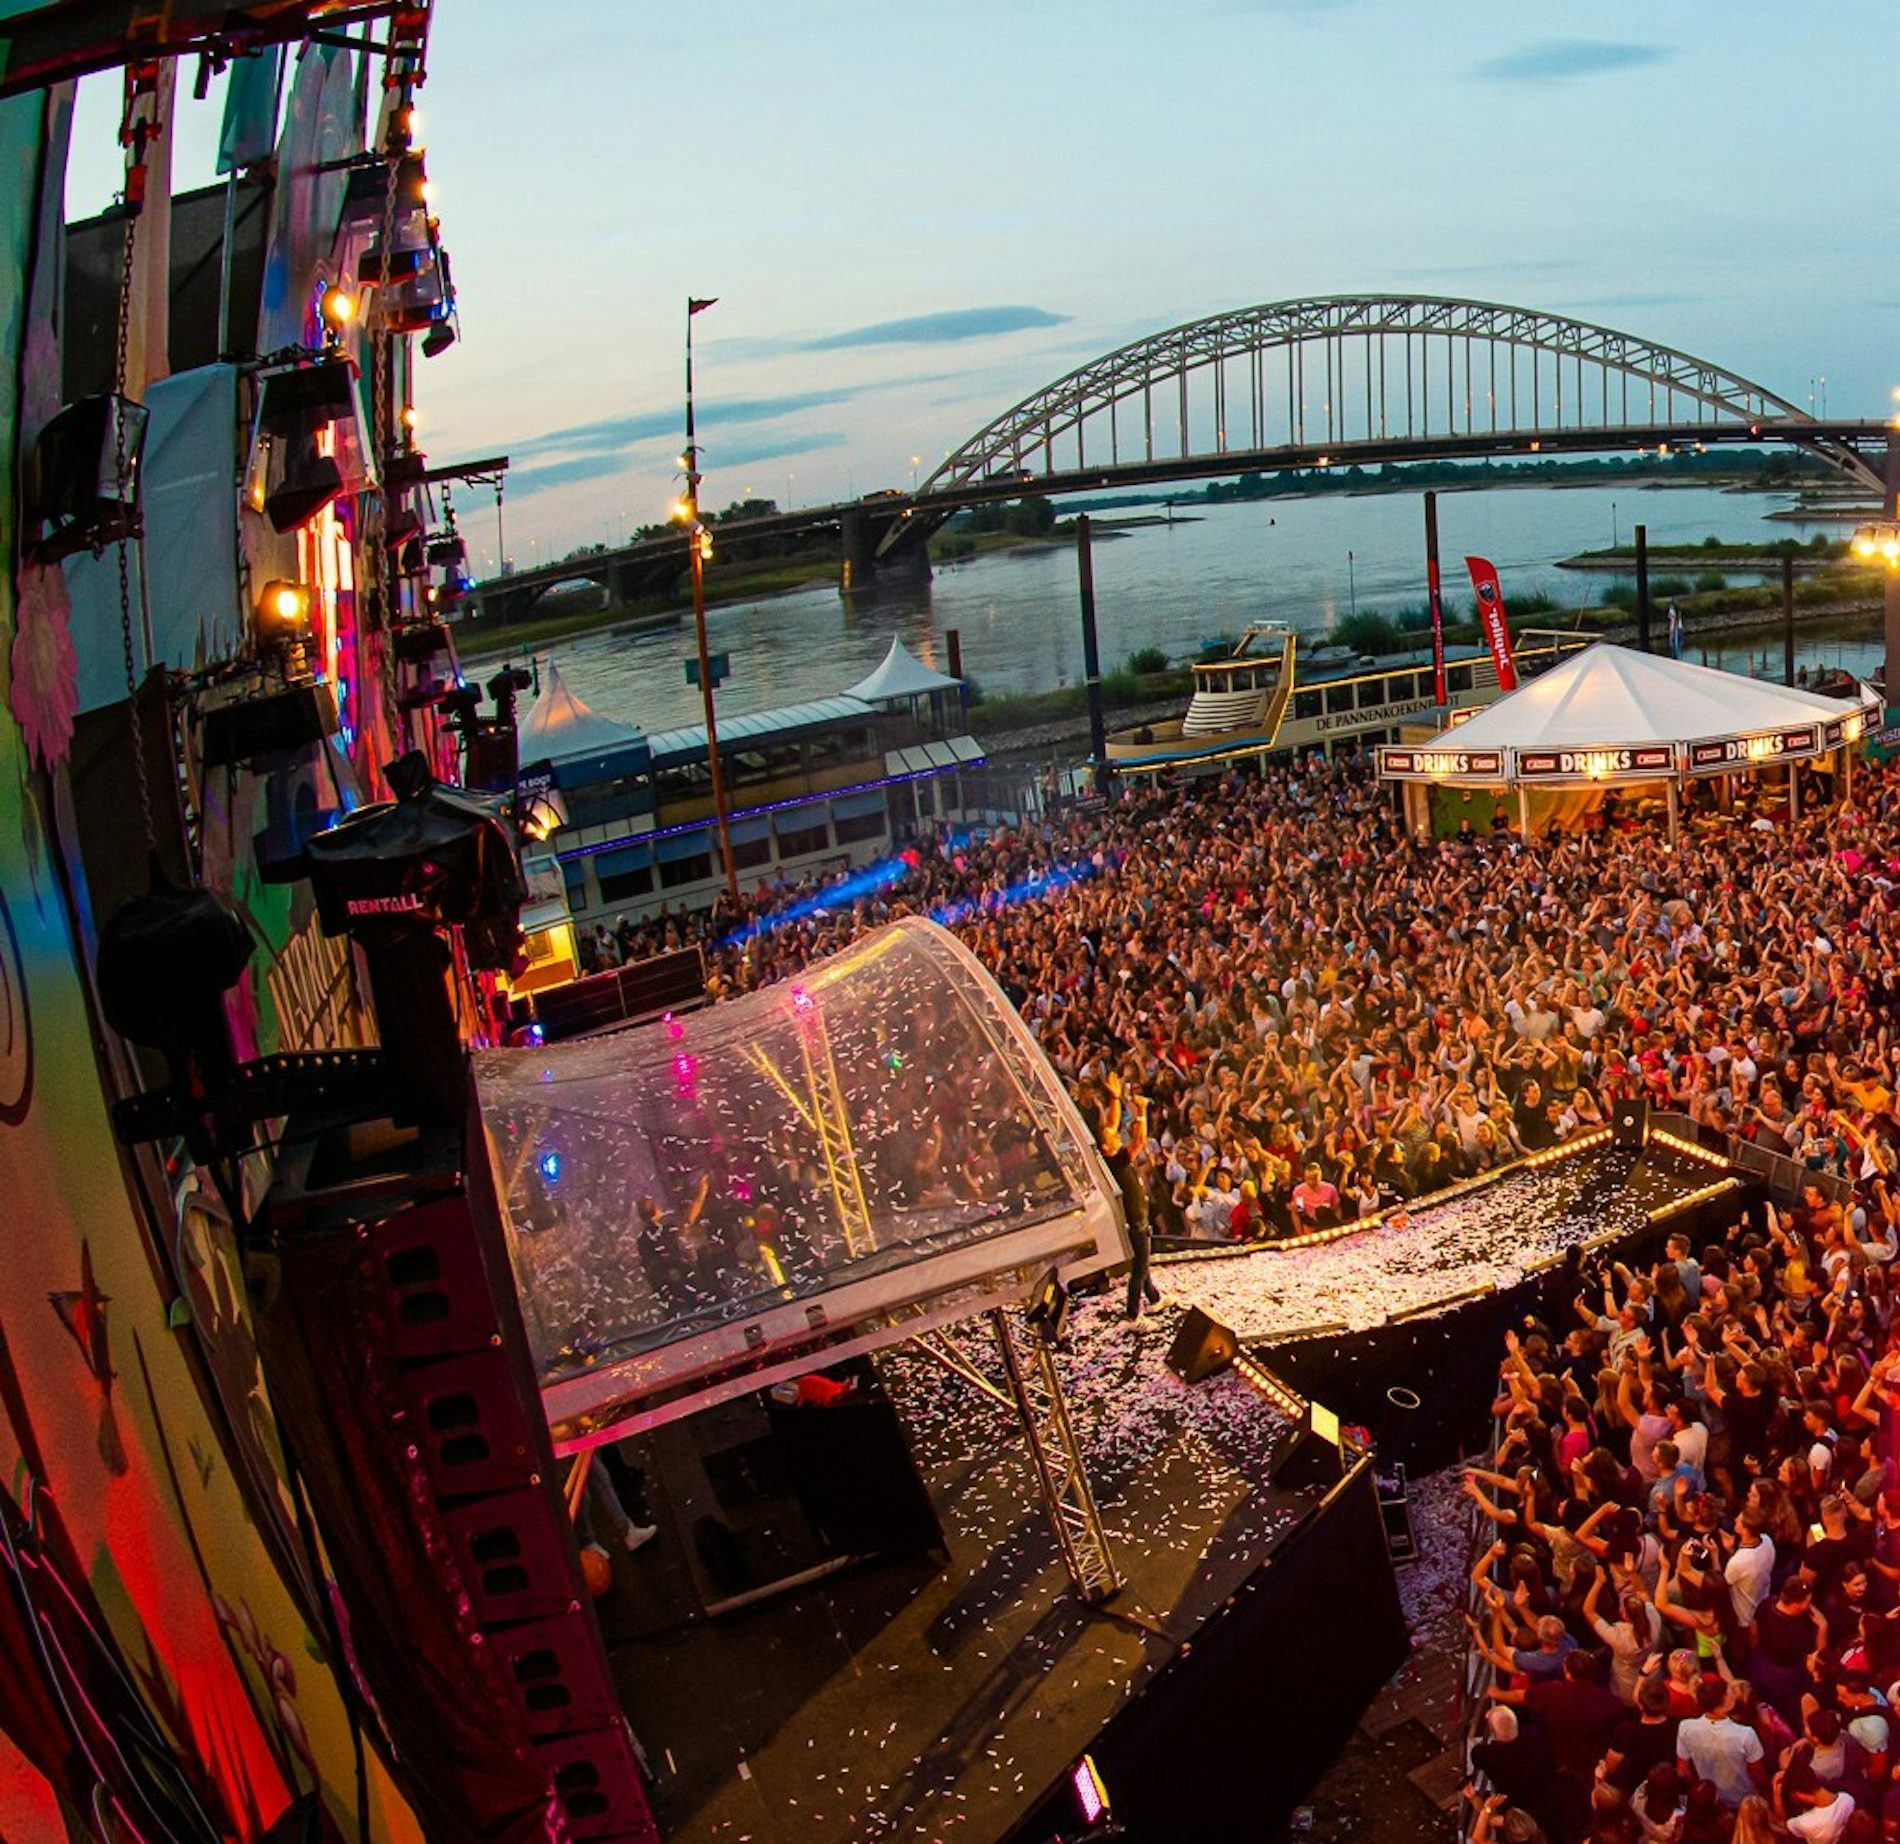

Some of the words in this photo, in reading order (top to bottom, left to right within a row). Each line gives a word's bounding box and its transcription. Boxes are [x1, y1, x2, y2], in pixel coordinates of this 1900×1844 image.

[1317, 718, 1333, 732] DE
[1726, 735, 1784, 761] DRINKS
[1413, 754, 1469, 773] DRINKS
[1560, 750, 1632, 773] DRINKS
[346, 893, 424, 916] RENTALL
